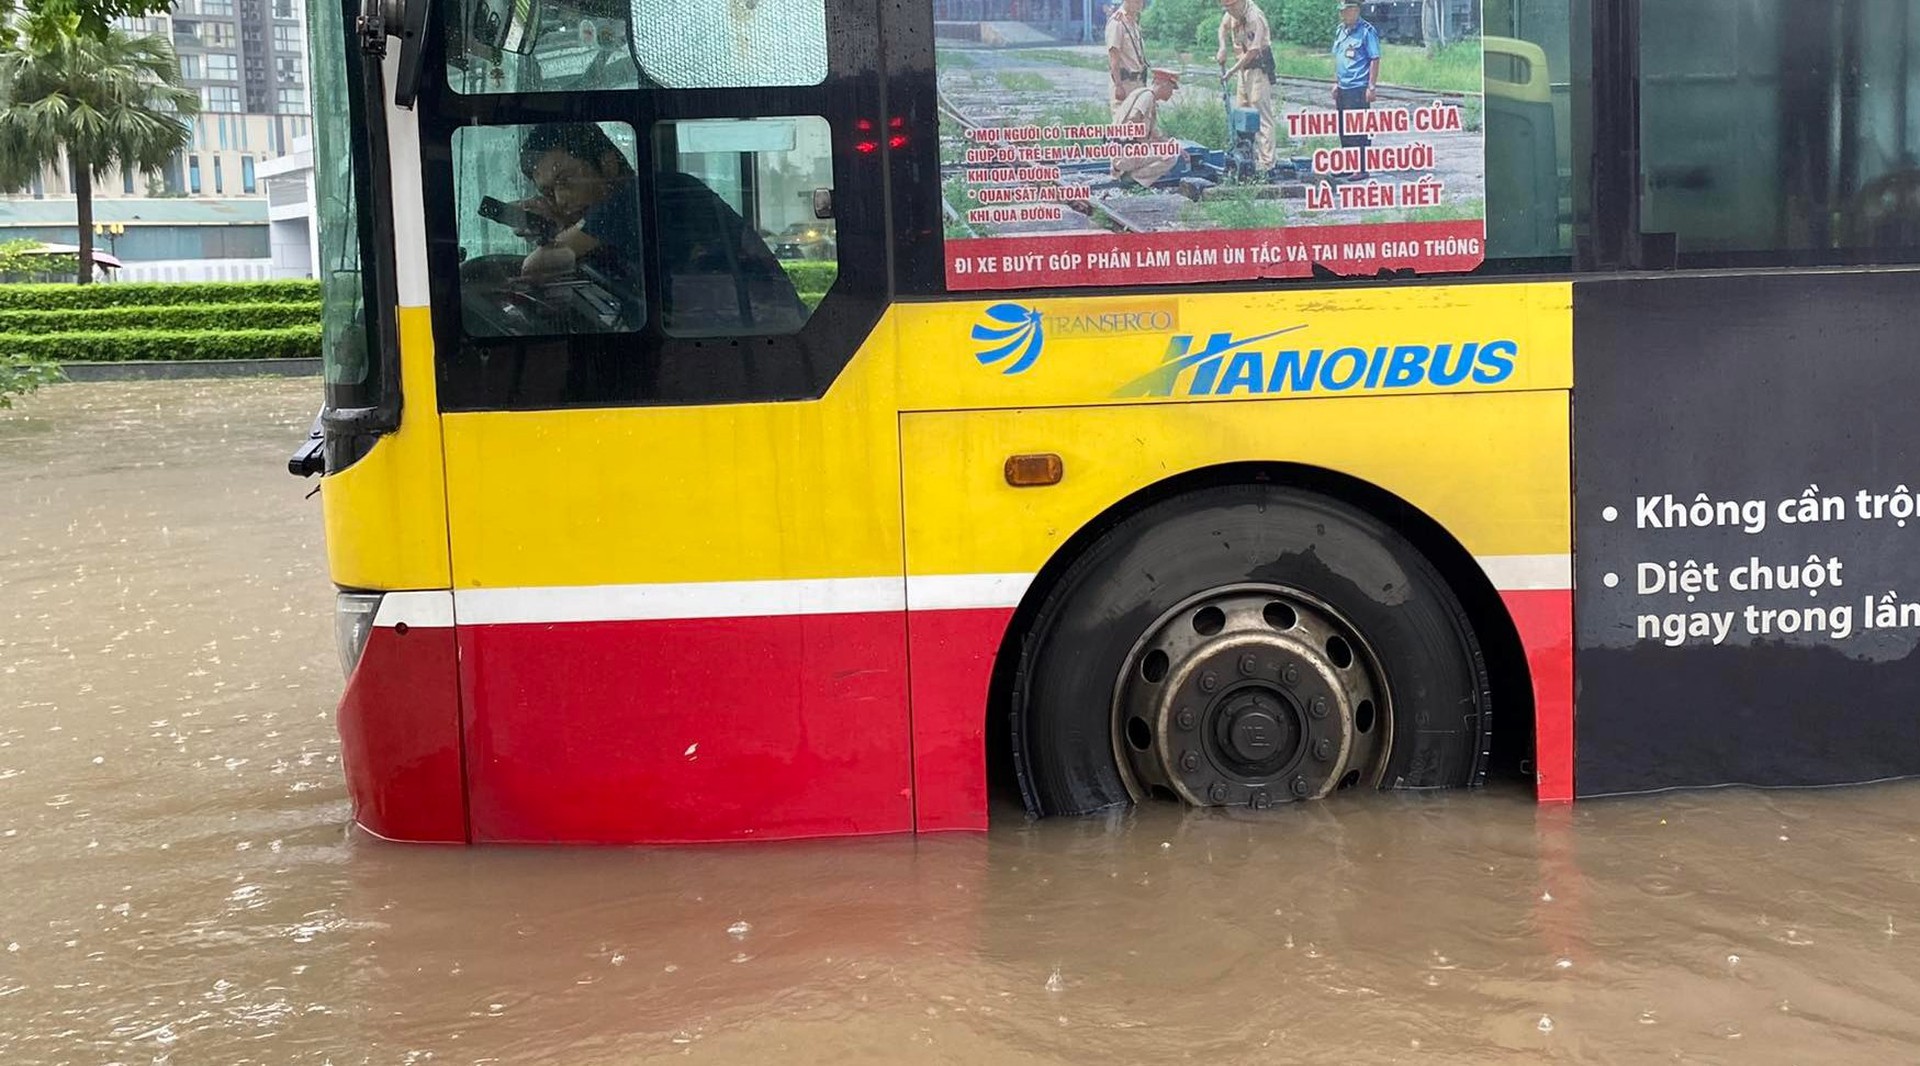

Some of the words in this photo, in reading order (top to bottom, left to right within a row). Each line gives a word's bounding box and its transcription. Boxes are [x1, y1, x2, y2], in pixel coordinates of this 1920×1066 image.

[976, 129, 1000, 144] MỌI
[1003, 125, 1040, 141] NGƯỜI
[1043, 124, 1060, 139] CÓ
[1064, 123, 1103, 139] TRÁCH
[1106, 122, 1145, 139] NHIỆM
[1287, 109, 1337, 136] TÍNH
[1345, 110, 1408, 138] MẠNG
[1415, 102, 1460, 131] CỦA
[967, 147, 996, 162] GIÚP
[998, 146, 1015, 161] ĐỠ
[1019, 144, 1042, 160] TRẺ
[1044, 147, 1062, 160] EM
[1066, 144, 1082, 159] VÀ
[1085, 142, 1121, 158] NGƯỜI
[1125, 144, 1149, 157] CAO
[1152, 138, 1179, 156] TUỔI
[1314, 149, 1359, 173] CON
[1367, 142, 1433, 171] NGƯỜI
[968, 170, 988, 182] KHI
[991, 169, 1015, 183] QUA
[1019, 166, 1059, 181] ĐƯỜNG
[980, 189, 1012, 204] QUAN
[1015, 186, 1037, 201] SÁT
[1040, 188, 1056, 200] AN
[1060, 182, 1090, 200] TOÀN
[1306, 181, 1333, 210] LÀ
[1339, 183, 1394, 209] TRÊN
[1402, 175, 1442, 206] HẾT
[970, 210, 990, 222] KHI
[993, 209, 1017, 223] QUA
[1020, 206, 1061, 221] ĐƯỜNG
[954, 257, 972, 274] ĐI
[977, 256, 997, 273] XE
[1002, 251, 1045, 272] BUÝT
[1049, 250, 1081, 271] GÓP
[1087, 246, 1131, 270] PHẦN
[1136, 247, 1170, 268] LÀM
[1175, 245, 1218, 267] GIẢM
[1223, 239, 1245, 264] ÙN
[1251, 238, 1281, 264] TẮC
[1287, 239, 1308, 262] VÀ
[1312, 244, 1338, 261] TAI
[1343, 243, 1376, 263] NẠN
[1381, 240, 1419, 258] GIAO
[1424, 235, 1479, 257] THÔNG
[1043, 311, 1172, 335] TRANSERCO
[1110, 330, 1518, 398] HANOIBUS
[1636, 493, 1767, 533] Không
[1777, 484, 1846, 524] cần
[1855, 484, 1920, 528] trộ
[1637, 560, 1719, 602] Diệt
[1729, 554, 1843, 598] chuột
[1637, 611, 1735, 647] ngay
[1744, 604, 1853, 639] trong
[1864, 590, 1920, 629] lần
